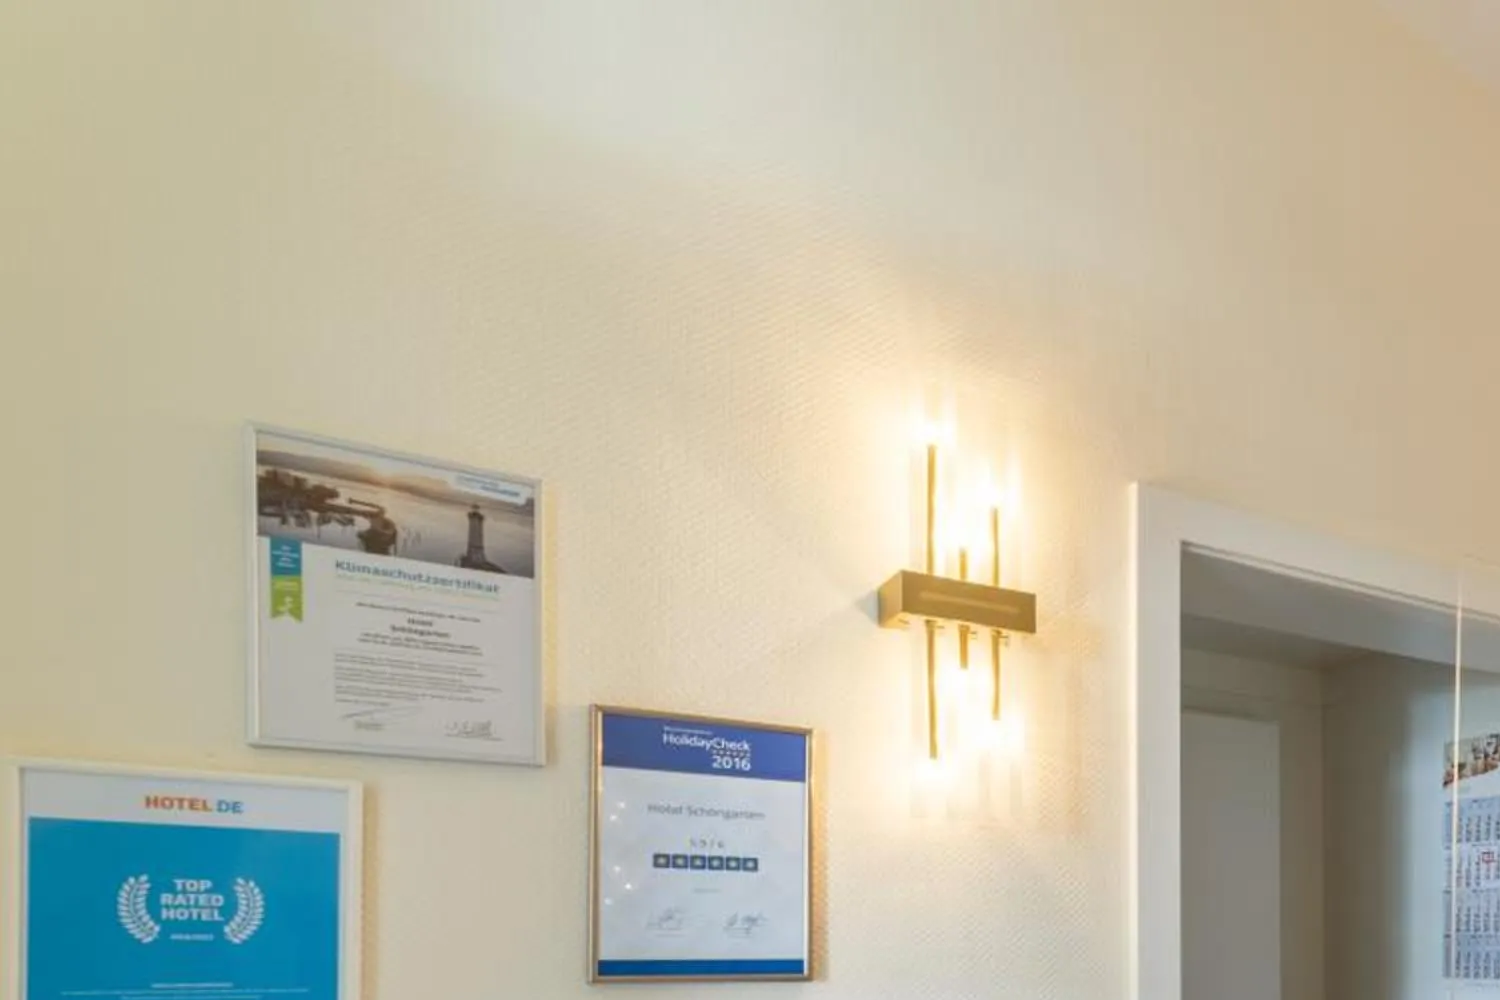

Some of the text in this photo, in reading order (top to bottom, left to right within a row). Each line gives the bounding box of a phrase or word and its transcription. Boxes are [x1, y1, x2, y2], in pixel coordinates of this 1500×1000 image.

[663, 733, 750, 751] HolidayCheck
[712, 754, 751, 771] 2016
[145, 796, 244, 814] HOTEL DE
[173, 879, 213, 892] TOP
[160, 893, 224, 907] RATED
[161, 908, 225, 921] HOTEL
